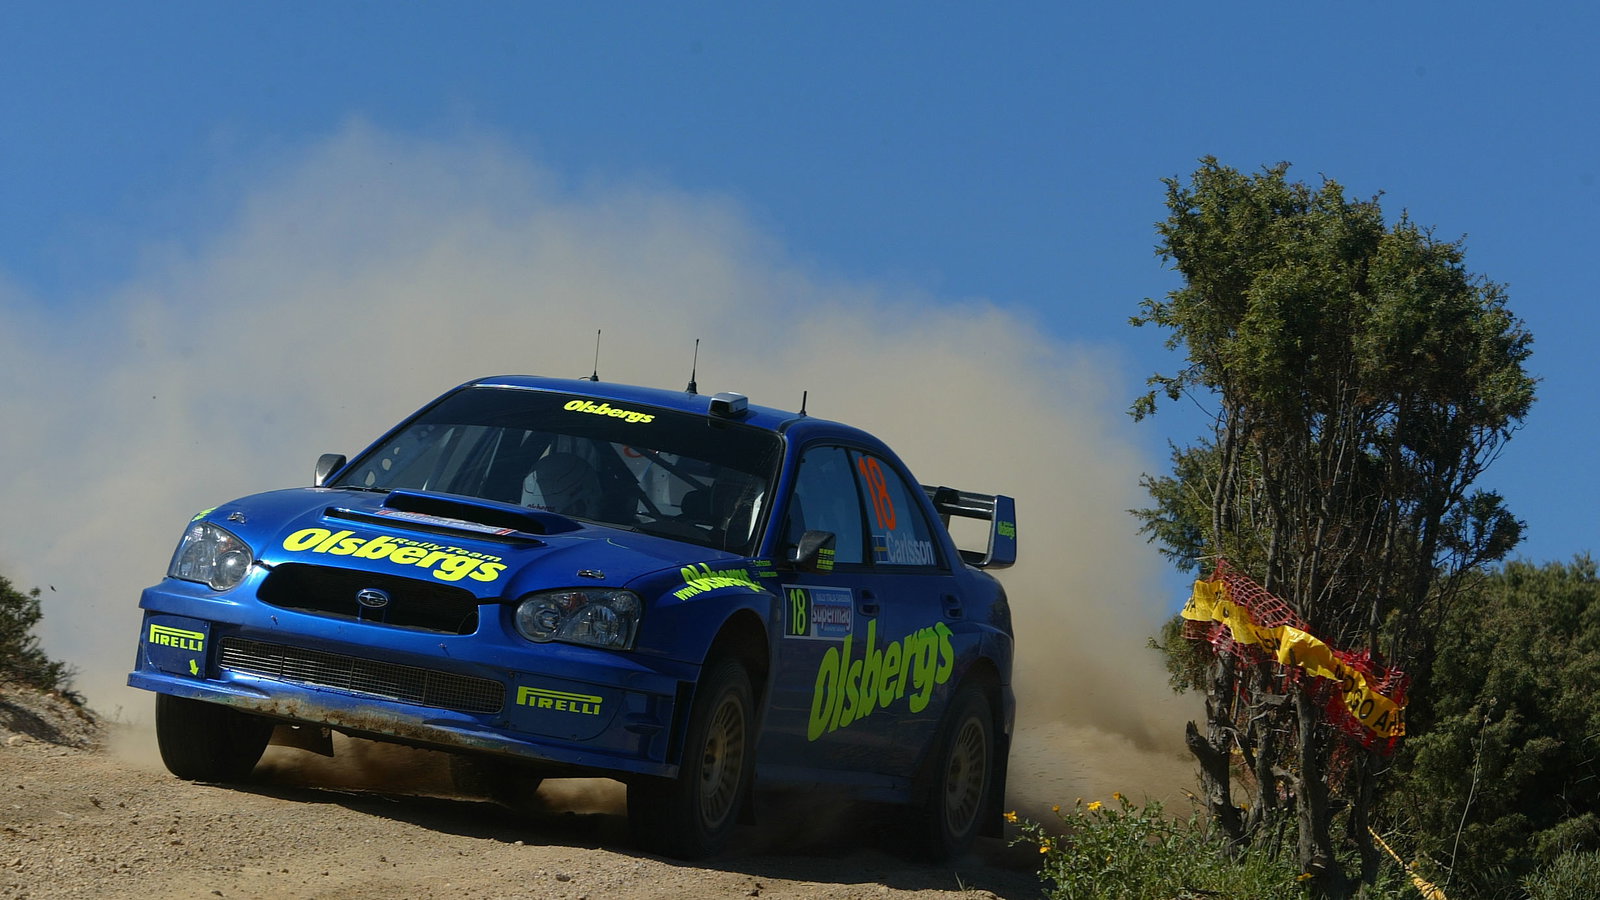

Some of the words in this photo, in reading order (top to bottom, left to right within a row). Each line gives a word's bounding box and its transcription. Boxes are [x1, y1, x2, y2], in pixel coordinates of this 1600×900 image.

[563, 400, 655, 423] Olsbergs
[858, 456, 897, 531] 18
[282, 528, 508, 582] Olsbergs
[390, 537, 446, 551] Rally
[445, 546, 503, 562] Team
[886, 532, 934, 565] Carlsson
[790, 588, 806, 635] 18
[812, 606, 851, 630] supermag
[149, 623, 205, 652] PIRELLI
[807, 618, 955, 742] Olsbergs
[516, 685, 603, 715] PIRELLI
